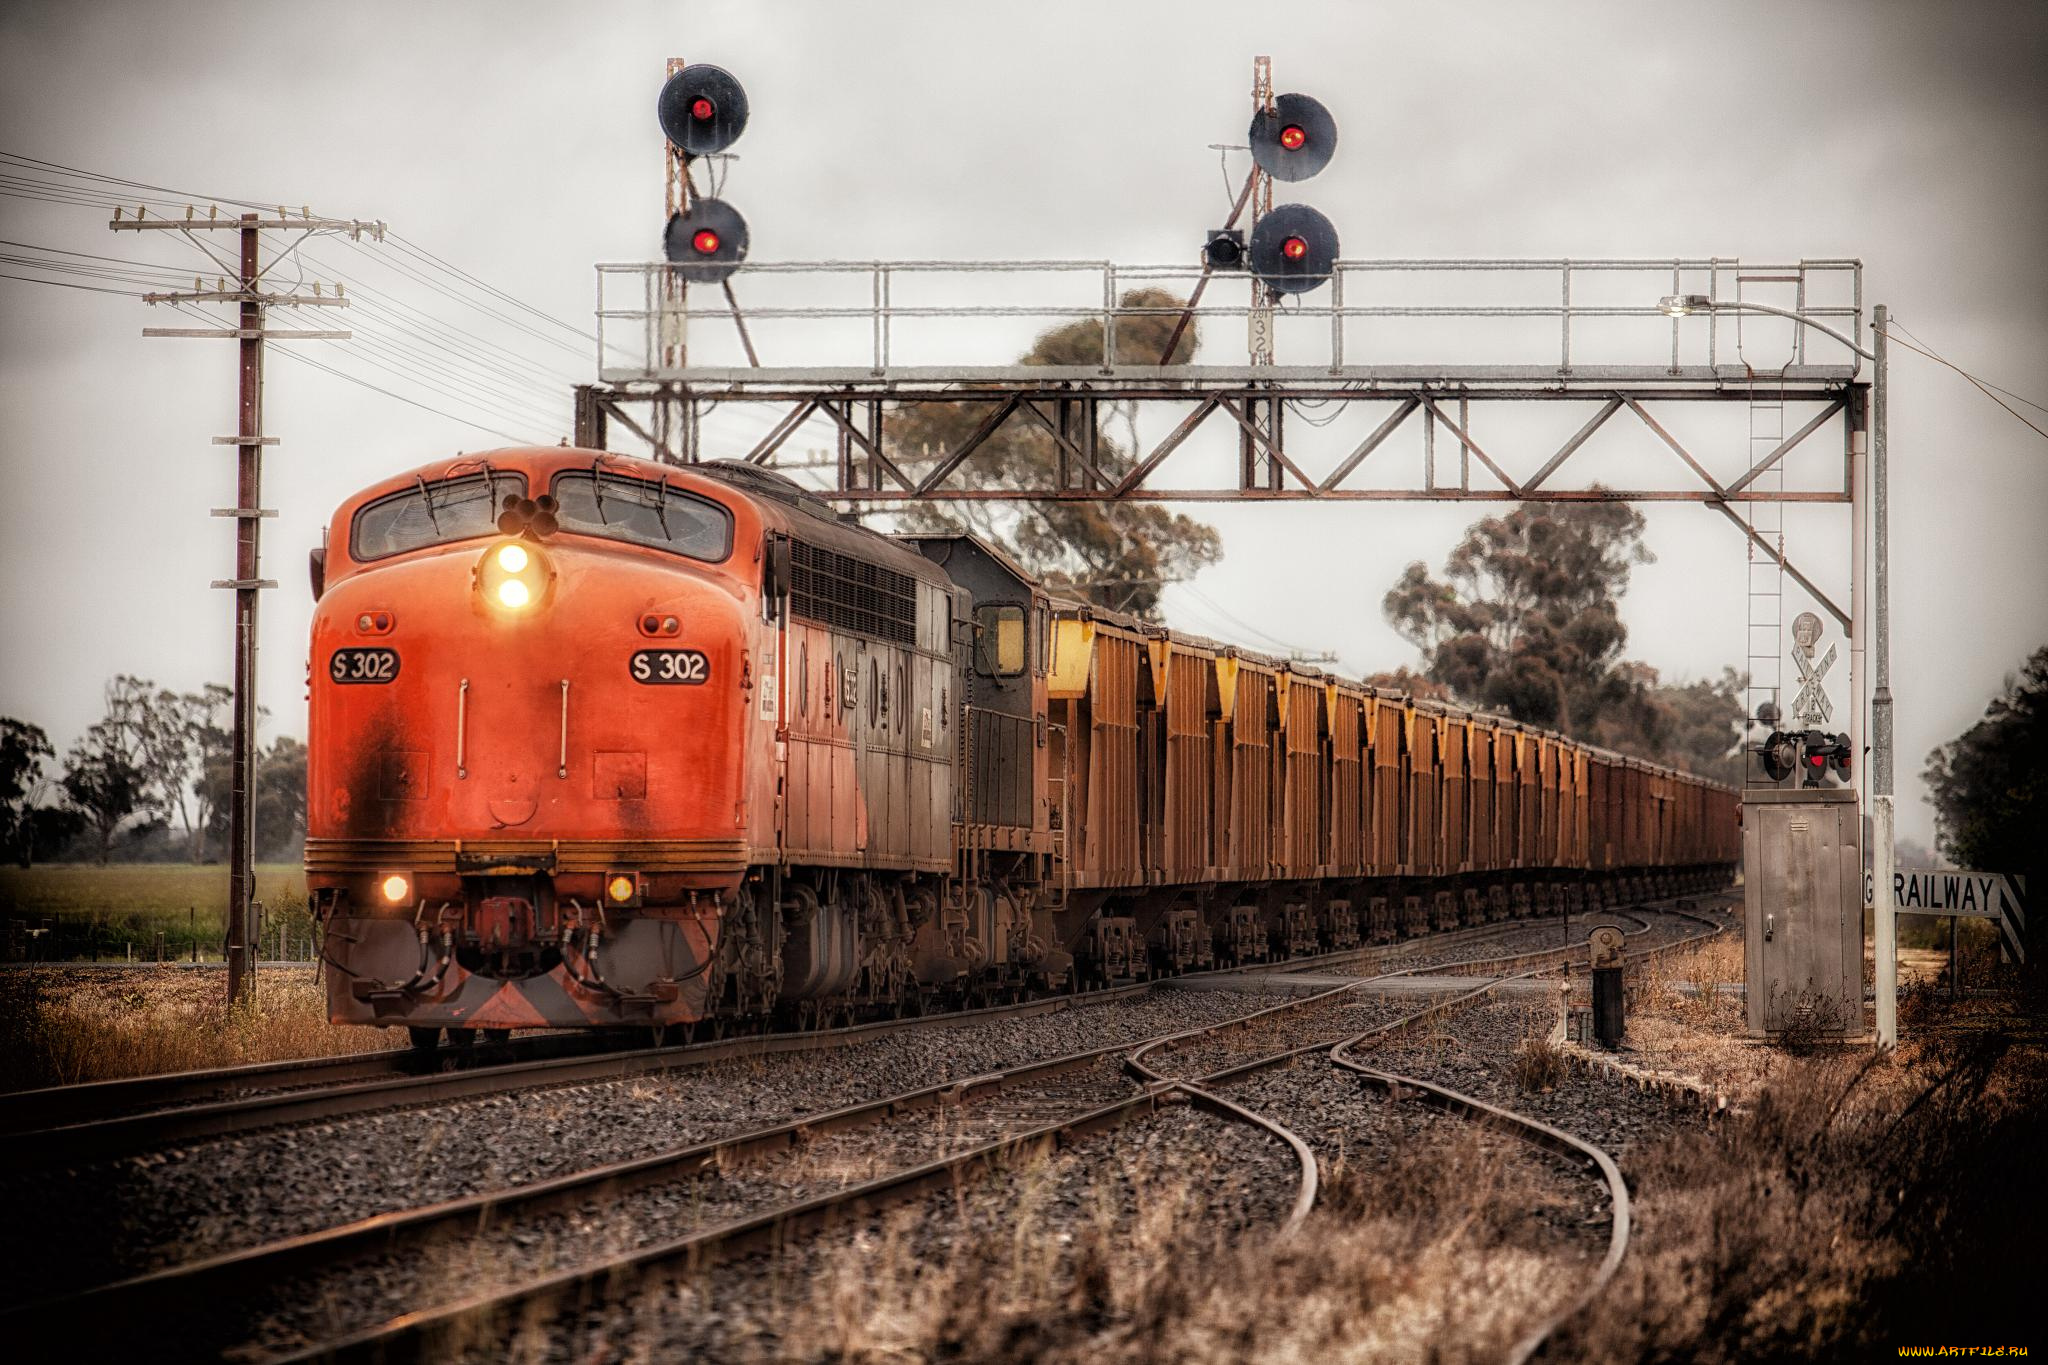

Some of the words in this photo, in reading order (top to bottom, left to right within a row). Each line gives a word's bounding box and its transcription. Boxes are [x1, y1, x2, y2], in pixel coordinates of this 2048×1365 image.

[333, 653, 347, 678] S
[351, 652, 394, 678] 302
[634, 654, 651, 679] S
[659, 653, 705, 679] 302
[1894, 873, 1994, 911] RAILWAY
